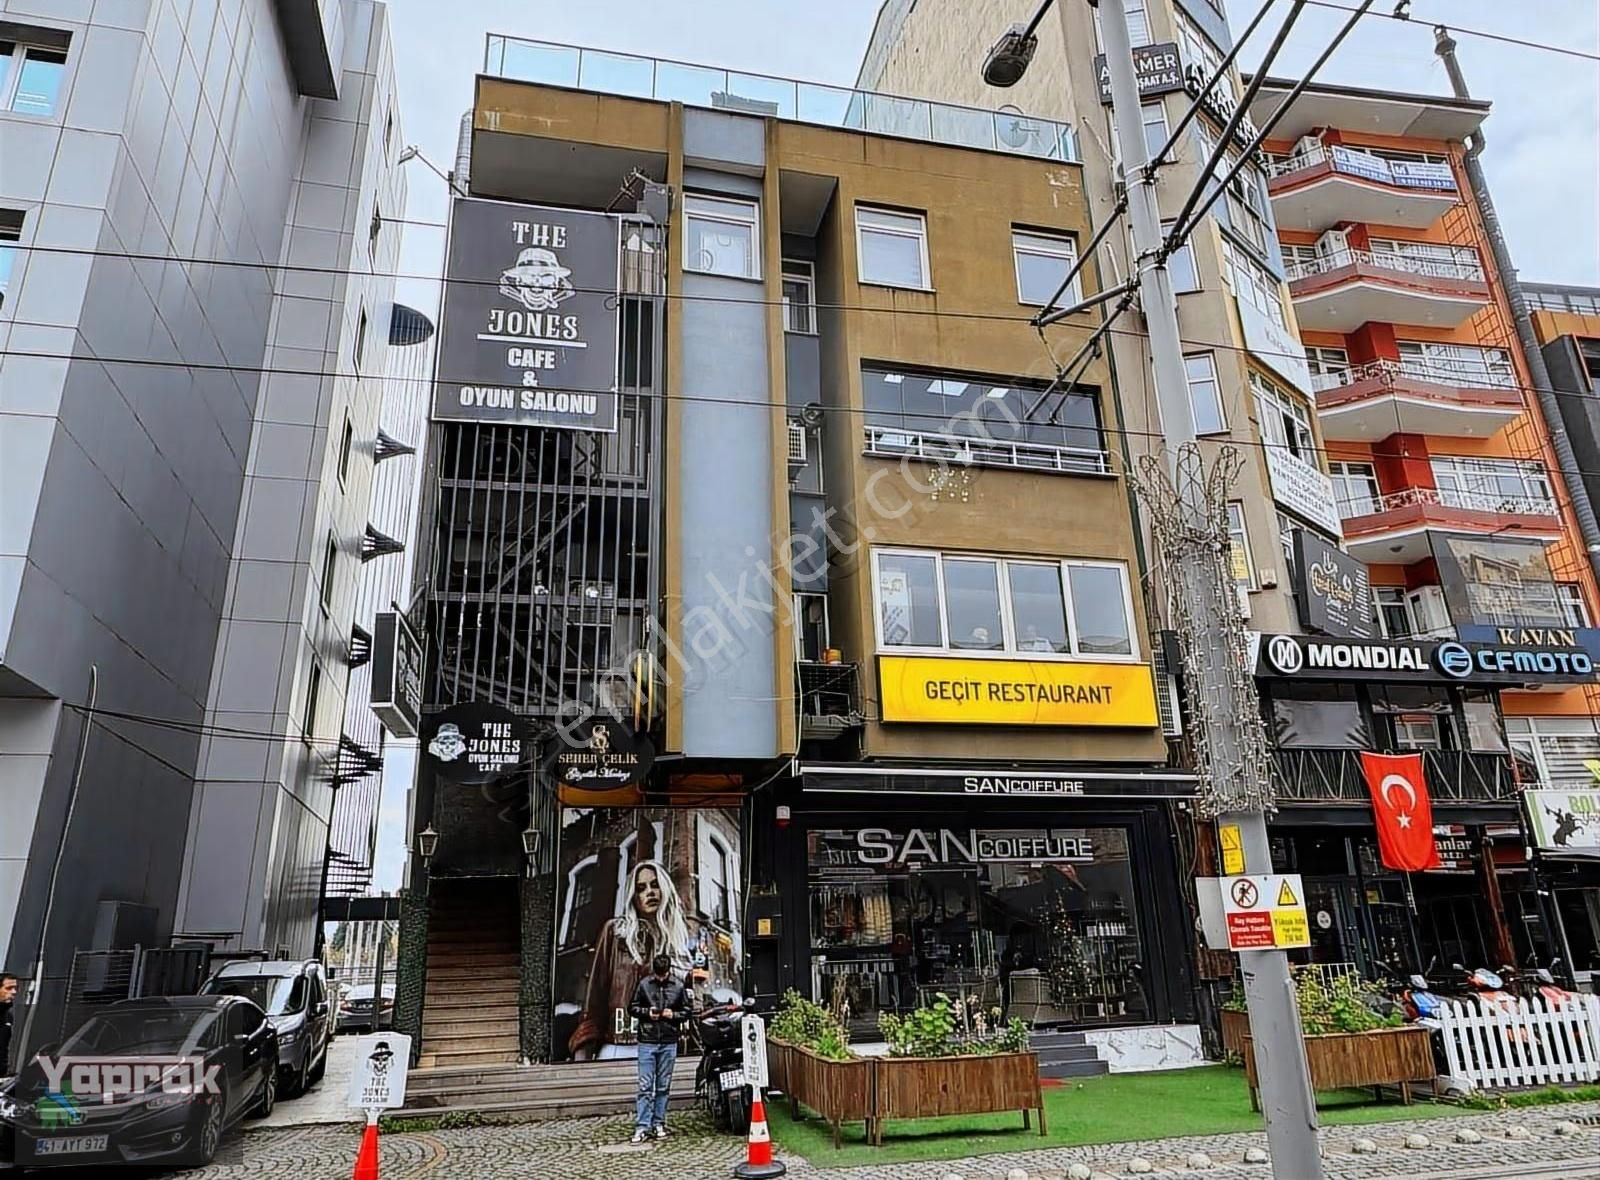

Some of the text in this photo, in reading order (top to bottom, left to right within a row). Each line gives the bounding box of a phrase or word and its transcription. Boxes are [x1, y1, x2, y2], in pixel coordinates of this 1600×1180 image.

[512, 221, 567, 248] THE
[488, 309, 579, 340] JONES
[507, 347, 555, 370] CAFE
[522, 371, 538, 388] &
[460, 387, 597, 415] OYUN SALONU
[1498, 627, 1577, 647] KAVAN
[1308, 643, 1430, 671] MONDIAL
[1477, 651, 1593, 674] CFMOTO
[925, 676, 1113, 705] GEÇİT RESTAURANT
[482, 722, 511, 737] THE
[468, 739, 520, 753] JONES
[479, 764, 501, 772] CAFE
[602, 752, 639, 766] ÇELİK
[1434, 837, 1472, 851] anlar
